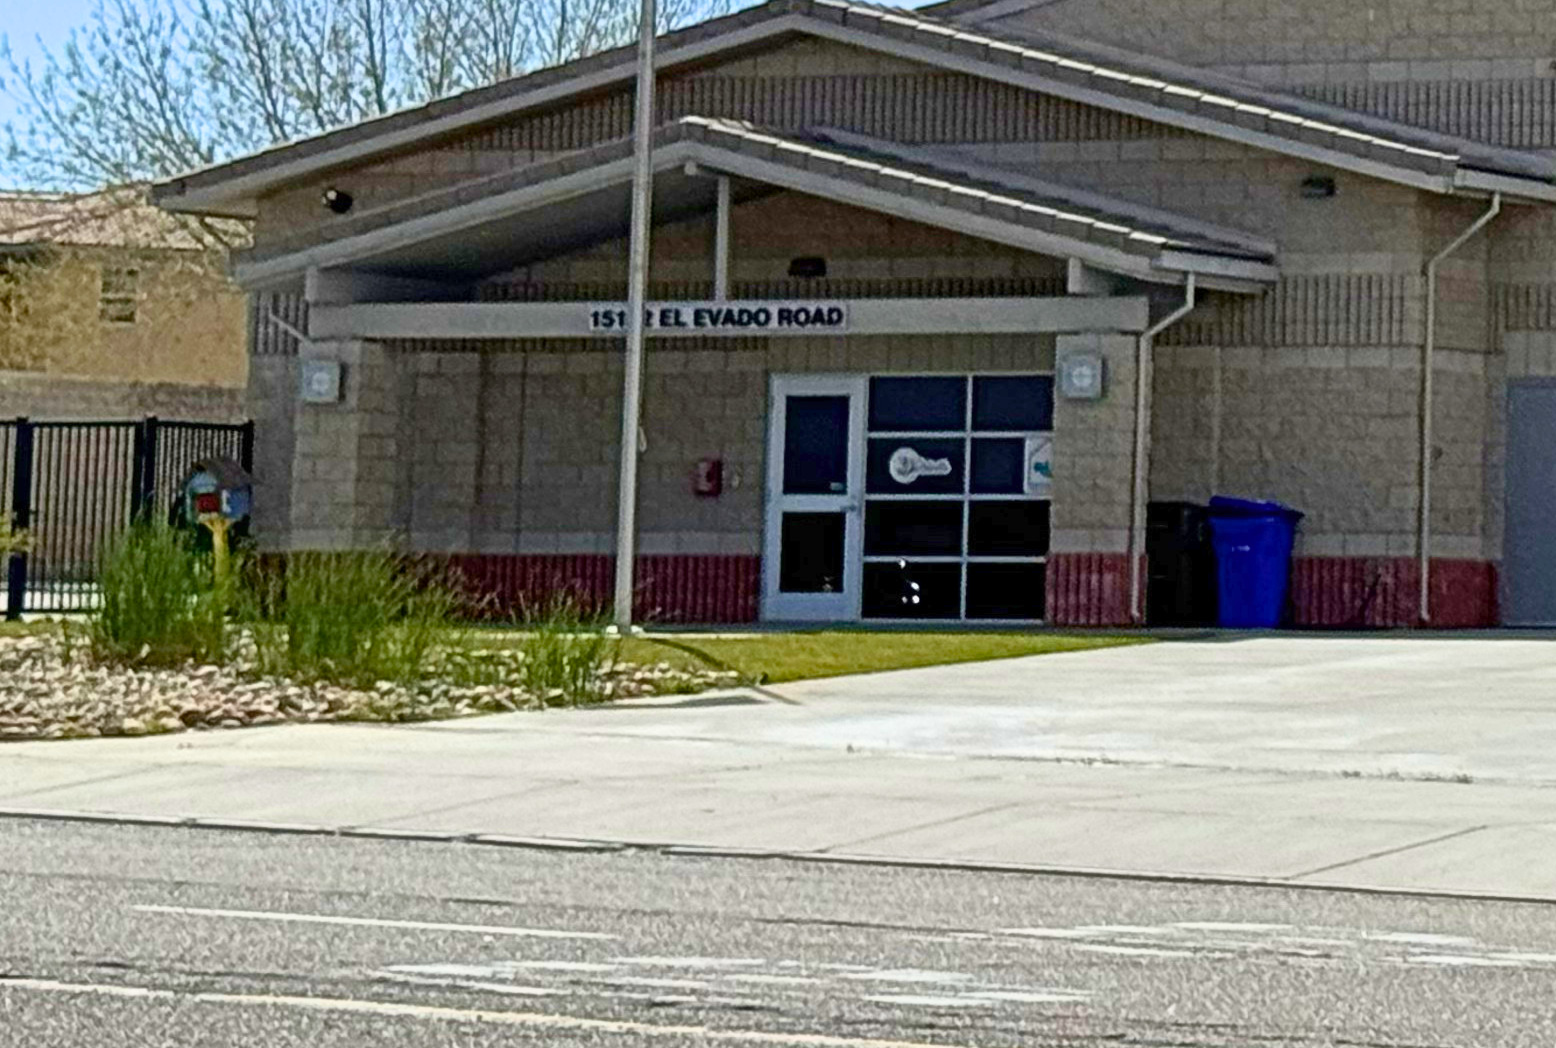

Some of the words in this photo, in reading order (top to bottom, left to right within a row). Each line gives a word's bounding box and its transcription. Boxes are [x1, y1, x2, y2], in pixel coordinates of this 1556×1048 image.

[659, 308, 687, 328] EL
[693, 307, 770, 328] EVADO
[777, 306, 844, 327] ROAD
